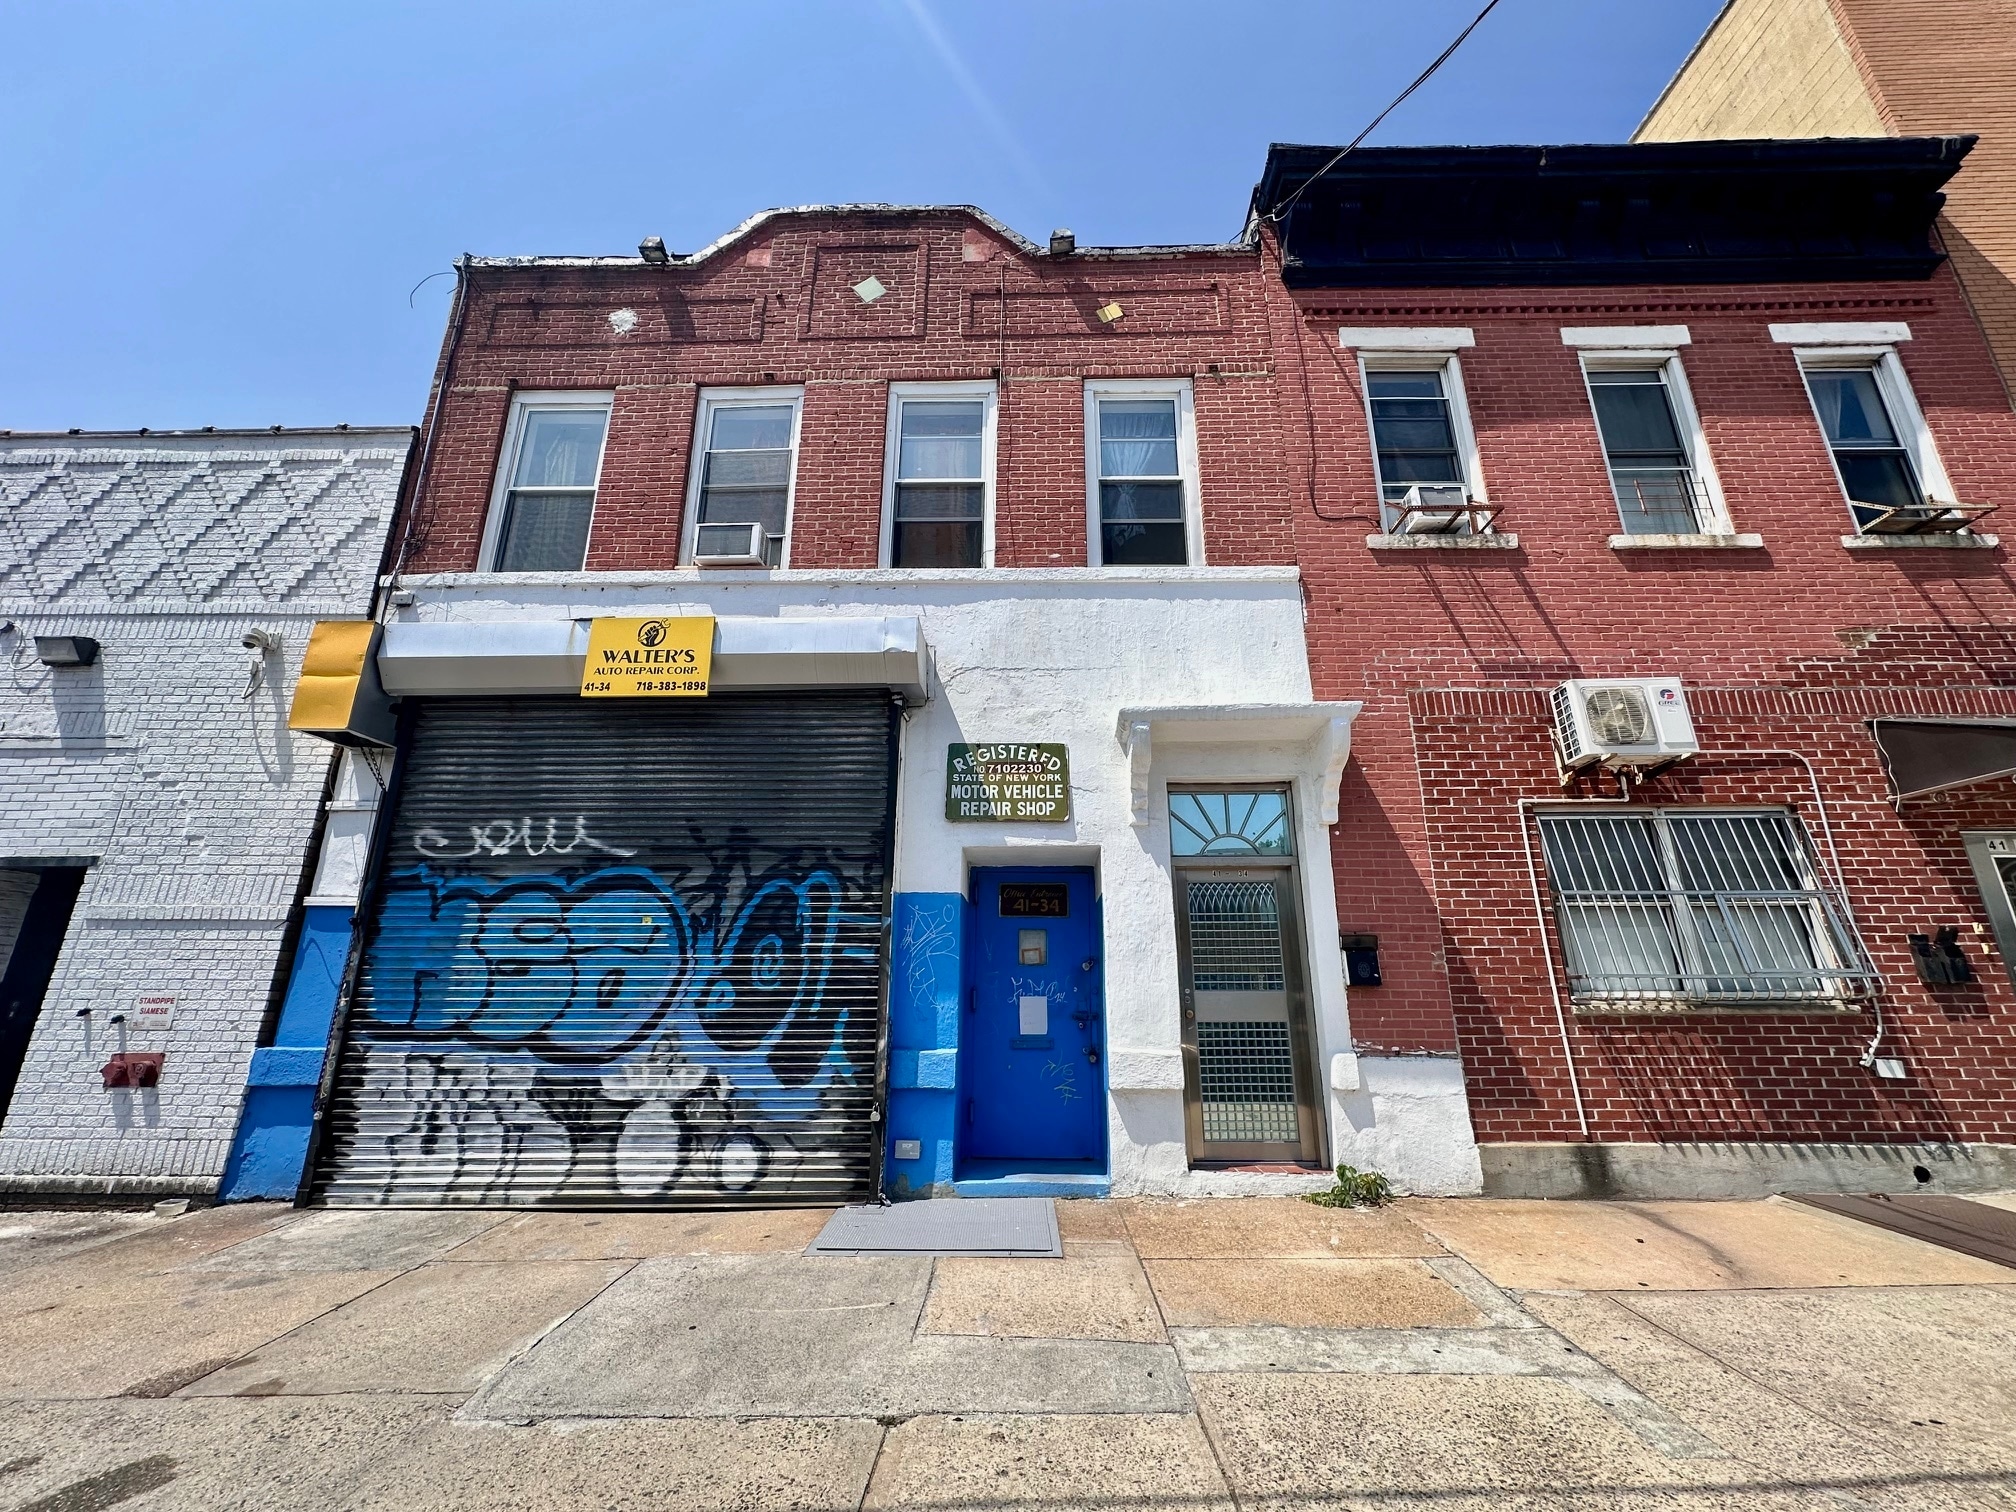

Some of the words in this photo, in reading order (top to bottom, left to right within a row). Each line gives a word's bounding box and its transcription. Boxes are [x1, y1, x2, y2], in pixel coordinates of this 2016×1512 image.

[602, 649, 695, 663] WALTER'S
[593, 666, 623, 676] AUTO
[625, 666, 664, 676] REPAIR
[667, 666, 700, 675] CORP.
[584, 682, 611, 692] 41-34
[636, 681, 707, 691] 718-383-1898
[987, 764, 1042, 774] 7102230
[953, 774, 985, 782] STATE
[988, 774, 1003, 782] OF
[1006, 774, 1029, 782] NEW
[1034, 773, 1062, 782] YORK
[951, 784, 999, 799] MOTOR
[1003, 784, 1064, 799] VEHICLE
[960, 801, 1012, 816] REPAIR
[1016, 801, 1056, 816] SHOP
[1989, 840, 2006, 850] 41
[1012, 898, 1060, 913] 41-34
